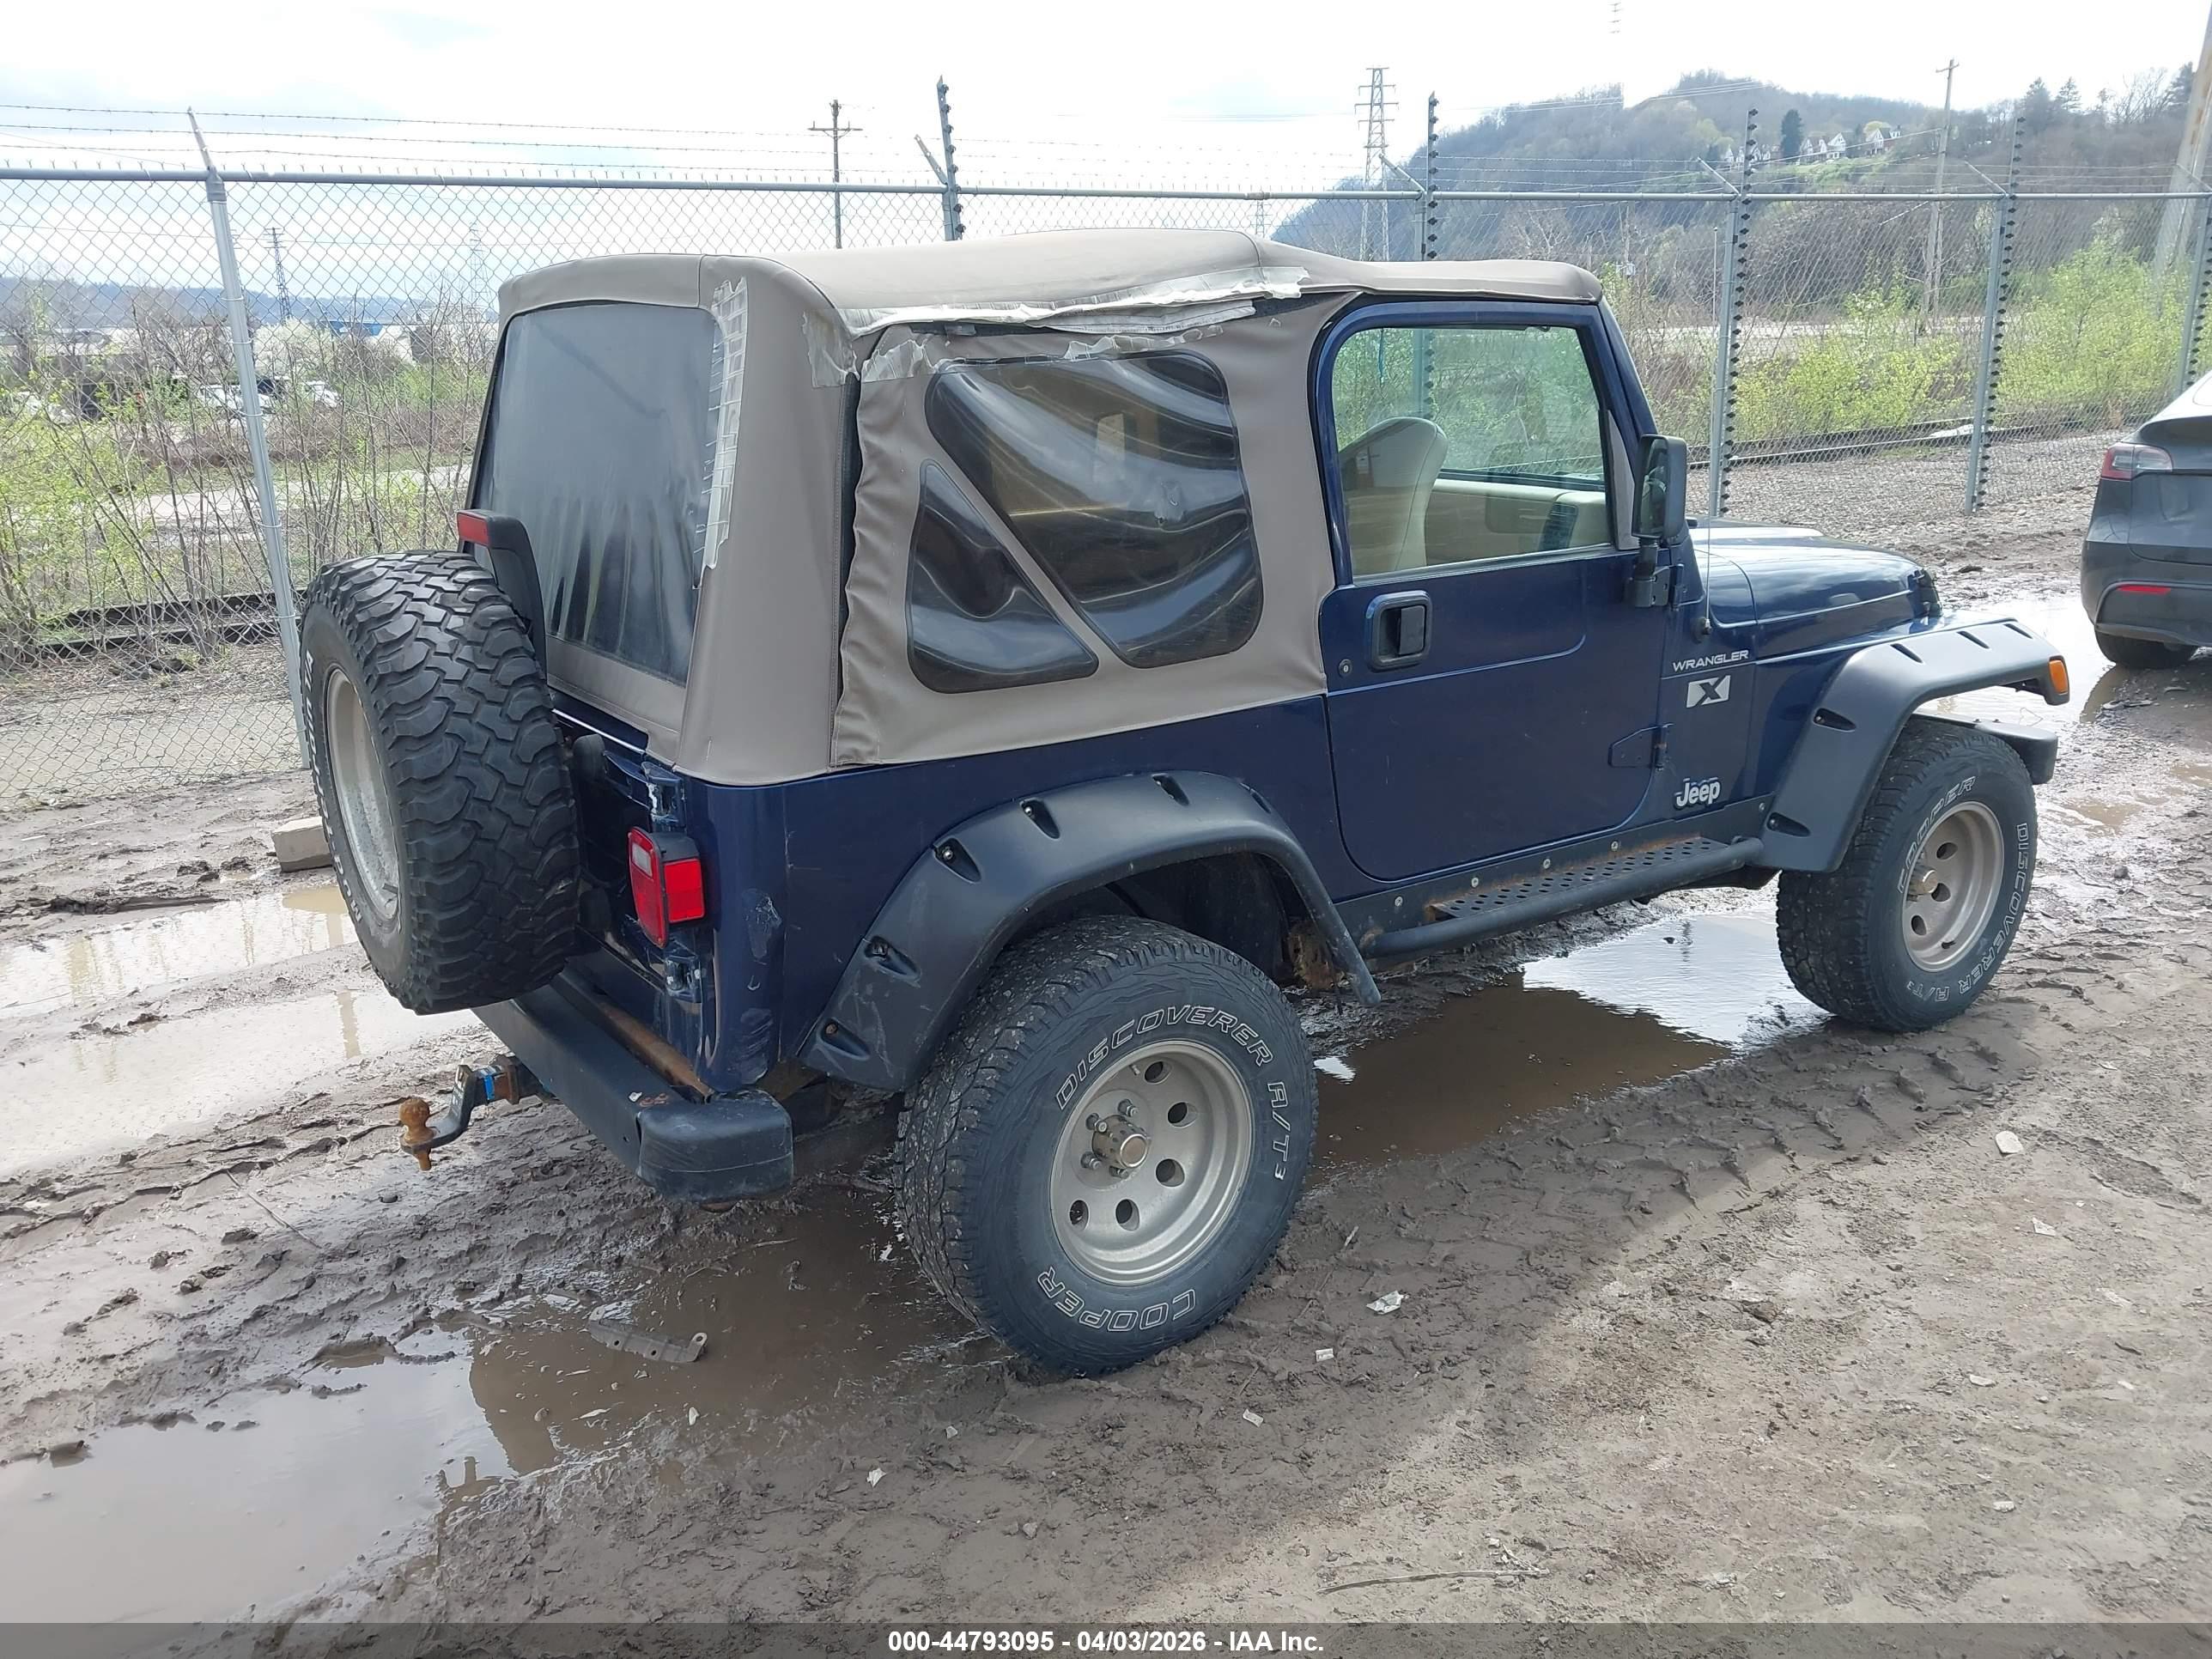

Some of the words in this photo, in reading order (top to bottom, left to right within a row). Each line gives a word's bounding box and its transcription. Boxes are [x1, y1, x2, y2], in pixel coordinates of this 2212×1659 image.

[1672, 649, 1749, 672] WRANGLER
[1688, 675, 1731, 708] X
[1675, 779, 1721, 808] Jeep
[1897, 775, 1976, 894] COOPER
[1957, 822, 2029, 995] DISCOVERER
[1055, 1004, 1273, 1110] DISCOVERER
[1036, 1266, 1197, 1332] COOPER
